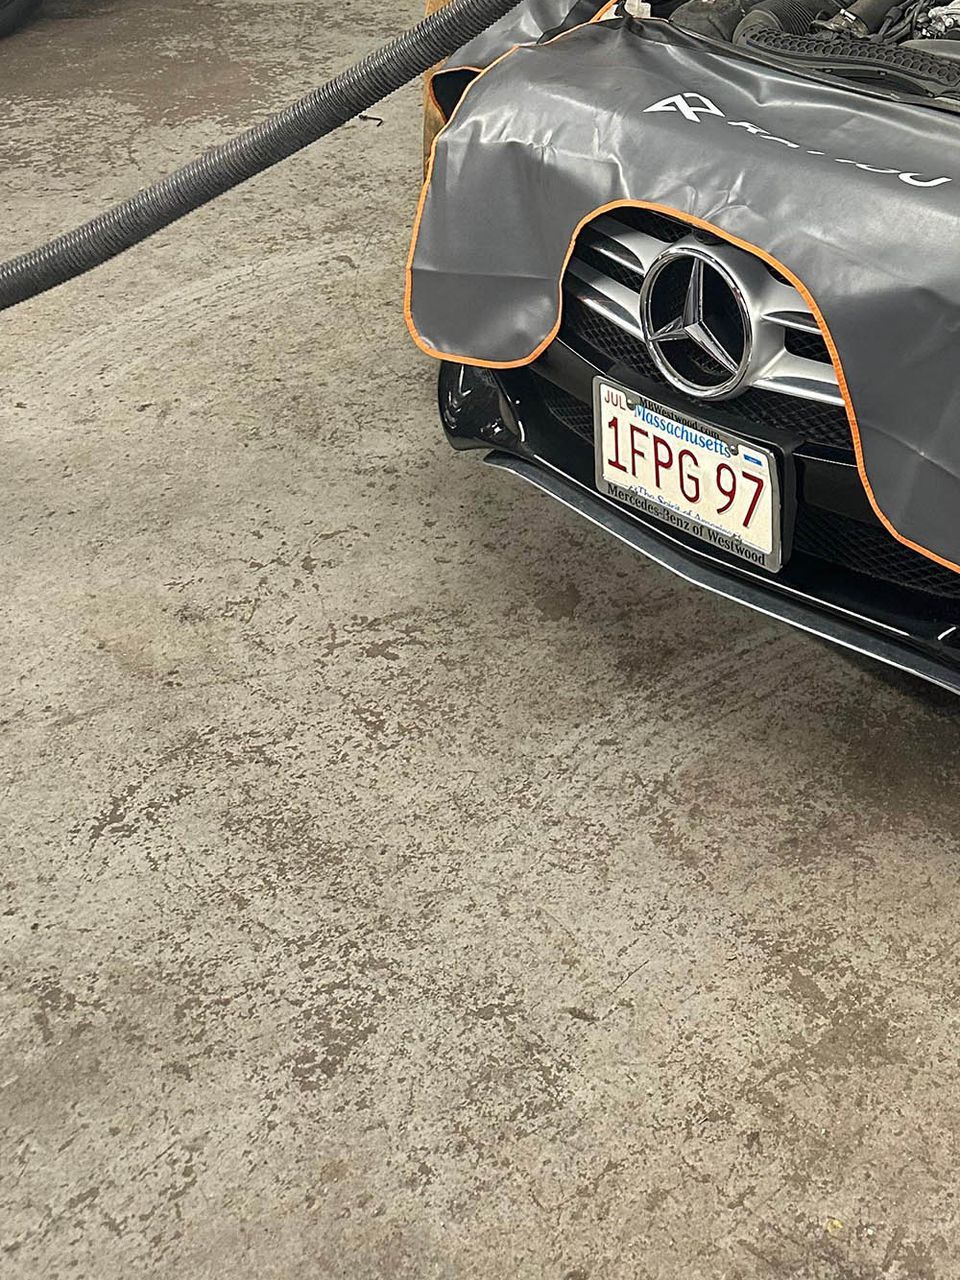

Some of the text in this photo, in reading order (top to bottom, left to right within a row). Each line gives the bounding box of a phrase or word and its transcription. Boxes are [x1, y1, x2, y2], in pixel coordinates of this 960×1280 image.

[604, 390, 626, 411] JUL
[634, 404, 732, 459] Massachusetts
[607, 416, 765, 529] 1FPG 97
[606, 482, 690, 531] Mercedes-Benz
[692, 523, 704, 537] of
[706, 528, 766, 567] Westwood
